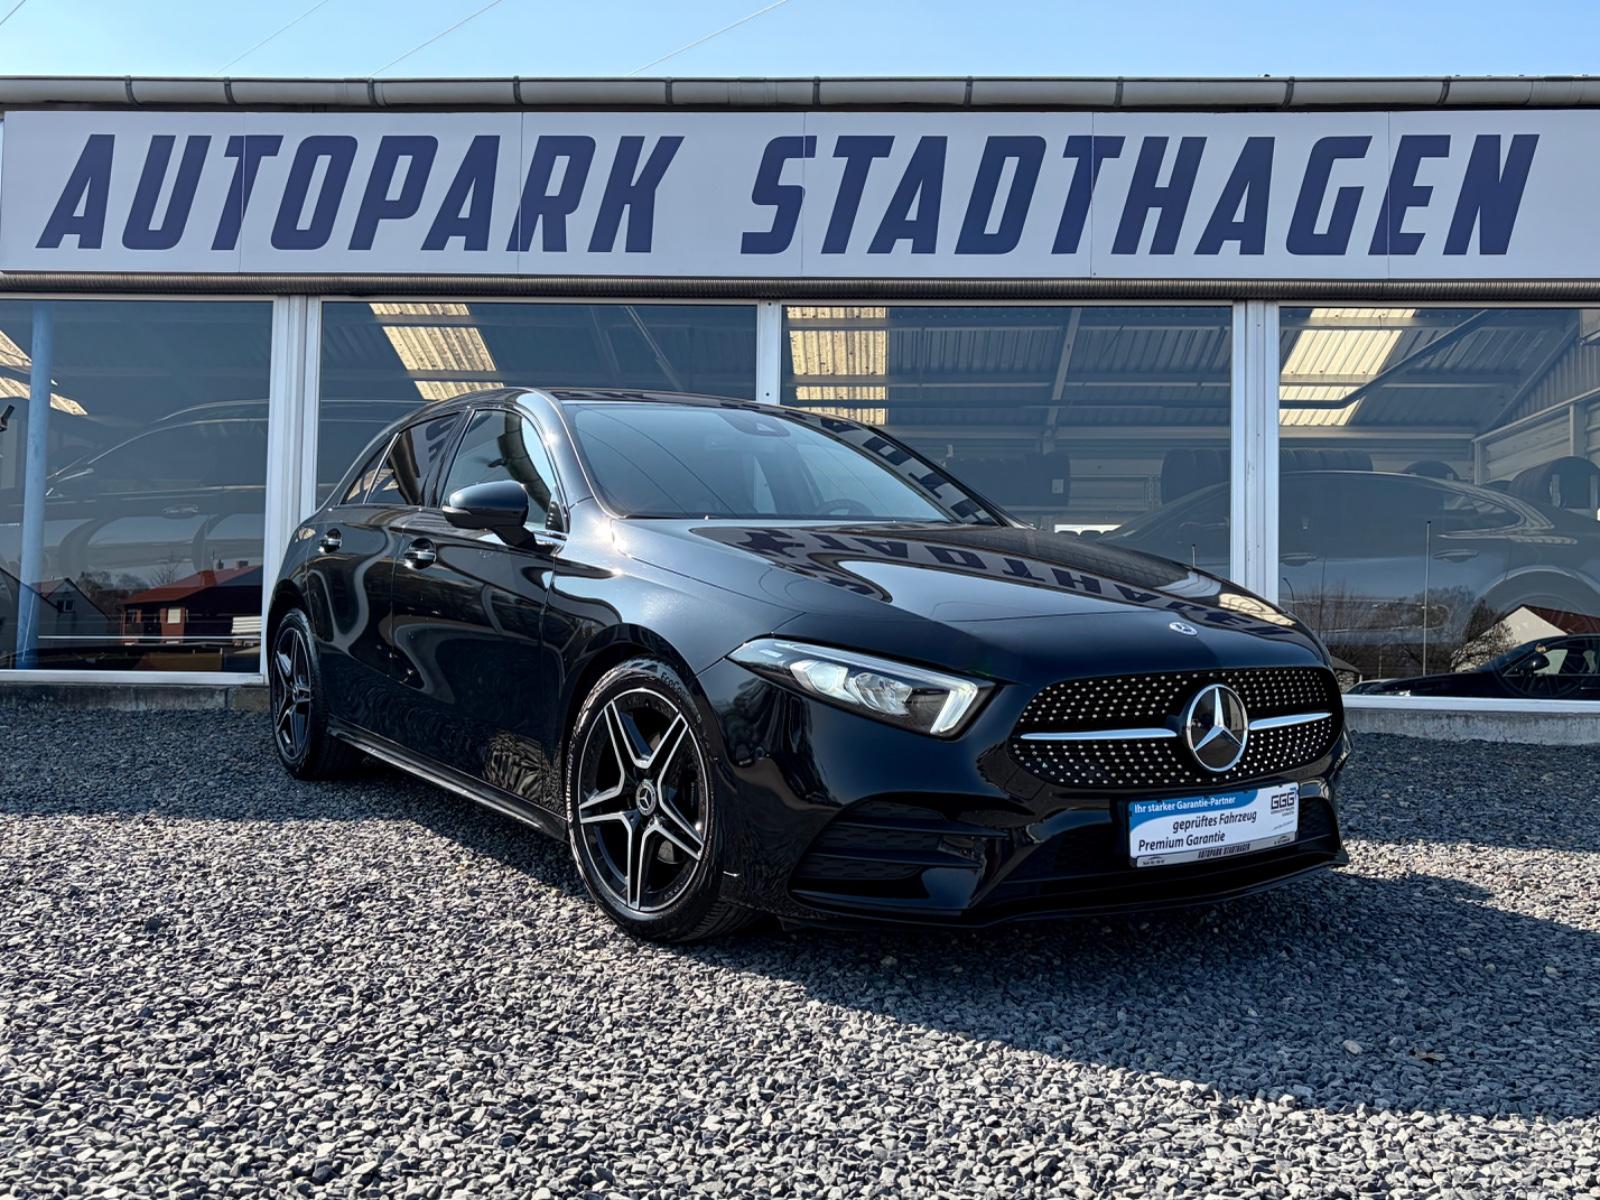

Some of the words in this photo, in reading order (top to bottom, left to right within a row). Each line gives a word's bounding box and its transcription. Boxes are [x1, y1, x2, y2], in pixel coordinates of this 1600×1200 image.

[36, 134, 684, 253] AUTOPARK
[740, 134, 1539, 256] STADTHAGEN
[1134, 803, 1147, 814] Ihr
[1148, 801, 1175, 812] starker
[1176, 796, 1236, 810] Garantie-Partner
[1271, 792, 1295, 809] GGG
[1172, 814, 1218, 834] geprüftes
[1219, 810, 1257, 825] Fahrzeug
[1138, 837, 1184, 852] Premium
[1186, 831, 1226, 847] Garantie
